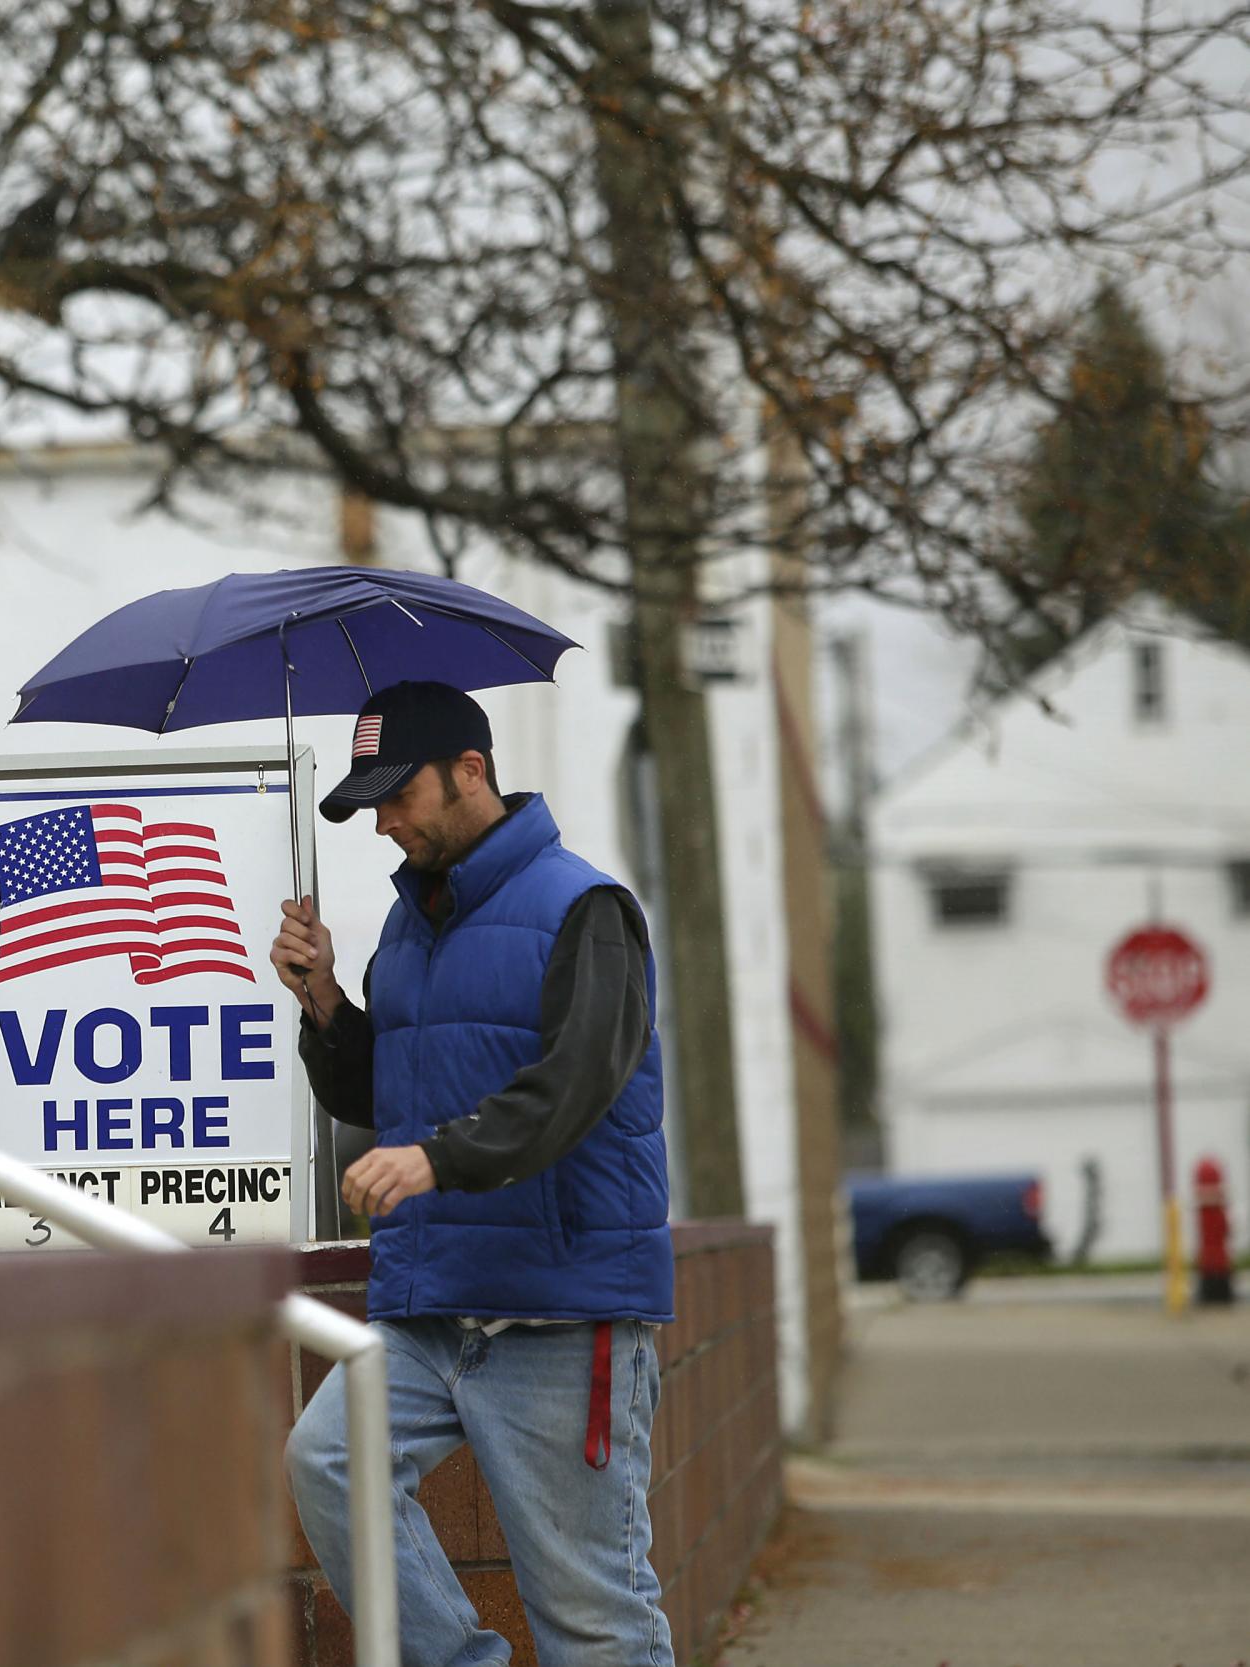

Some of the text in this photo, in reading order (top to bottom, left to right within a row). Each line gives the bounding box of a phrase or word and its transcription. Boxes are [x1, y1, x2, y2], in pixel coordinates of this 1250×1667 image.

[43, 1096, 230, 1152] HERE
[25, 1212, 52, 1247] 3
[208, 1207, 236, 1241] 4
